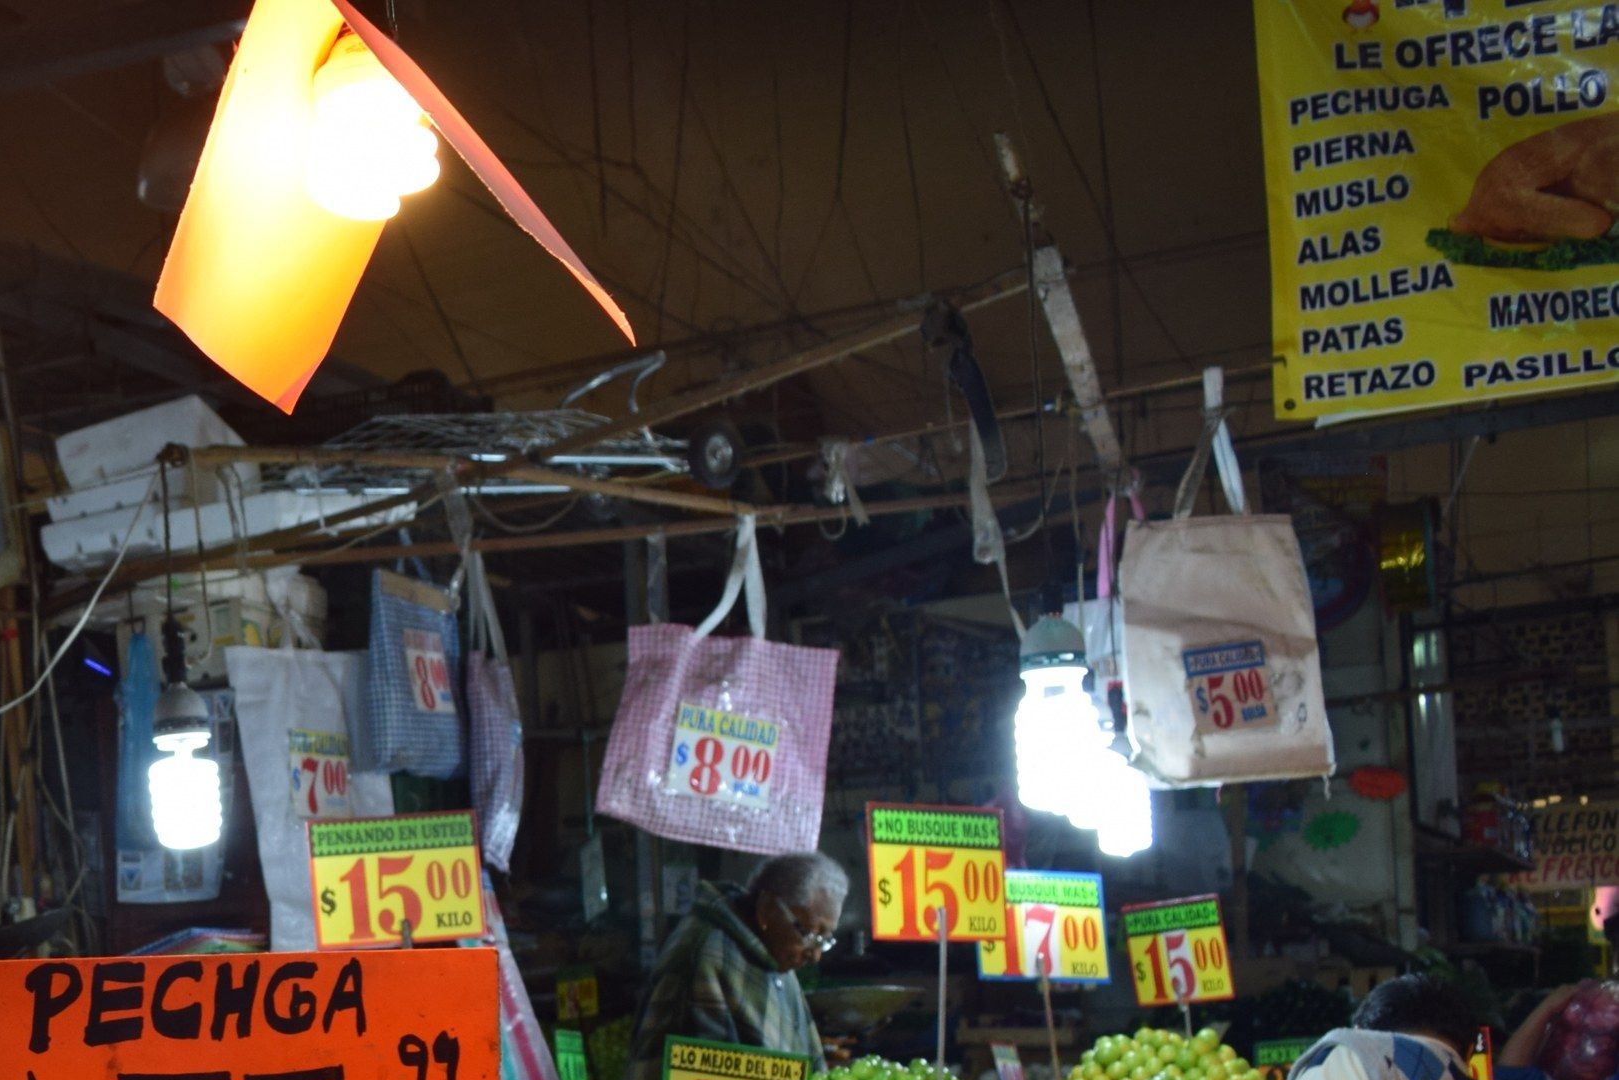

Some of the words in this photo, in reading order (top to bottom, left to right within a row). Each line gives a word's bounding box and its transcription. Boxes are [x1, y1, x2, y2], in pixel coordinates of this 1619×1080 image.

[1335, 42, 1381, 70] LE
[1395, 15, 1558, 69] OFRECE
[1290, 84, 1450, 125] PECHUGA
[1478, 69, 1608, 119] POLLO
[1293, 129, 1415, 171] PIERNA
[1295, 174, 1410, 218] MUSLO
[1297, 226, 1381, 265] ALAS
[1299, 263, 1454, 311] MOLLEJA
[1302, 318, 1404, 355] PATAS
[1304, 361, 1436, 399] RETAZO
[1193, 653, 1217, 669] PURA
[415, 655, 437, 710] 8
[1196, 685, 1209, 713] $
[1207, 675, 1234, 729] 5
[1233, 668, 1264, 704] 00
[682, 707, 716, 735] PURA
[719, 716, 778, 747] CALIDAD
[302, 757, 319, 815] 7
[323, 760, 347, 796] 00
[676, 742, 689, 766] $
[689, 736, 724, 796] 8
[731, 744, 771, 784] 00
[317, 827, 396, 848] PENSANDO
[399, 825, 419, 841] EN
[422, 820, 468, 839] USTED
[884, 816, 904, 836] NO
[907, 817, 959, 838] BUSQUE
[962, 818, 990, 839] MAS
[320, 887, 337, 915] $
[339, 855, 423, 940] 15
[426, 858, 471, 901] 00
[877, 878, 893, 906] $
[893, 846, 959, 938] 15
[963, 859, 1000, 903] 00
[1009, 881, 1058, 897] BUSQUE
[1062, 886, 1089, 899] MAS
[436, 911, 472, 928] KILO
[968, 914, 996, 932] KILO
[1002, 903, 1056, 976] 17
[1063, 915, 1098, 951] 00
[1133, 911, 1161, 929] PURA
[1072, 961, 1099, 976] KILO
[1136, 962, 1147, 981] $
[1145, 933, 1195, 999] 15
[1194, 937, 1223, 971] 00
[25, 957, 366, 1054] PECHGA
[680, 1049, 697, 1065] LO
[700, 1053, 742, 1072] MEJOR
[745, 1060, 767, 1076] DEL
[771, 1064, 792, 1079] DIA
